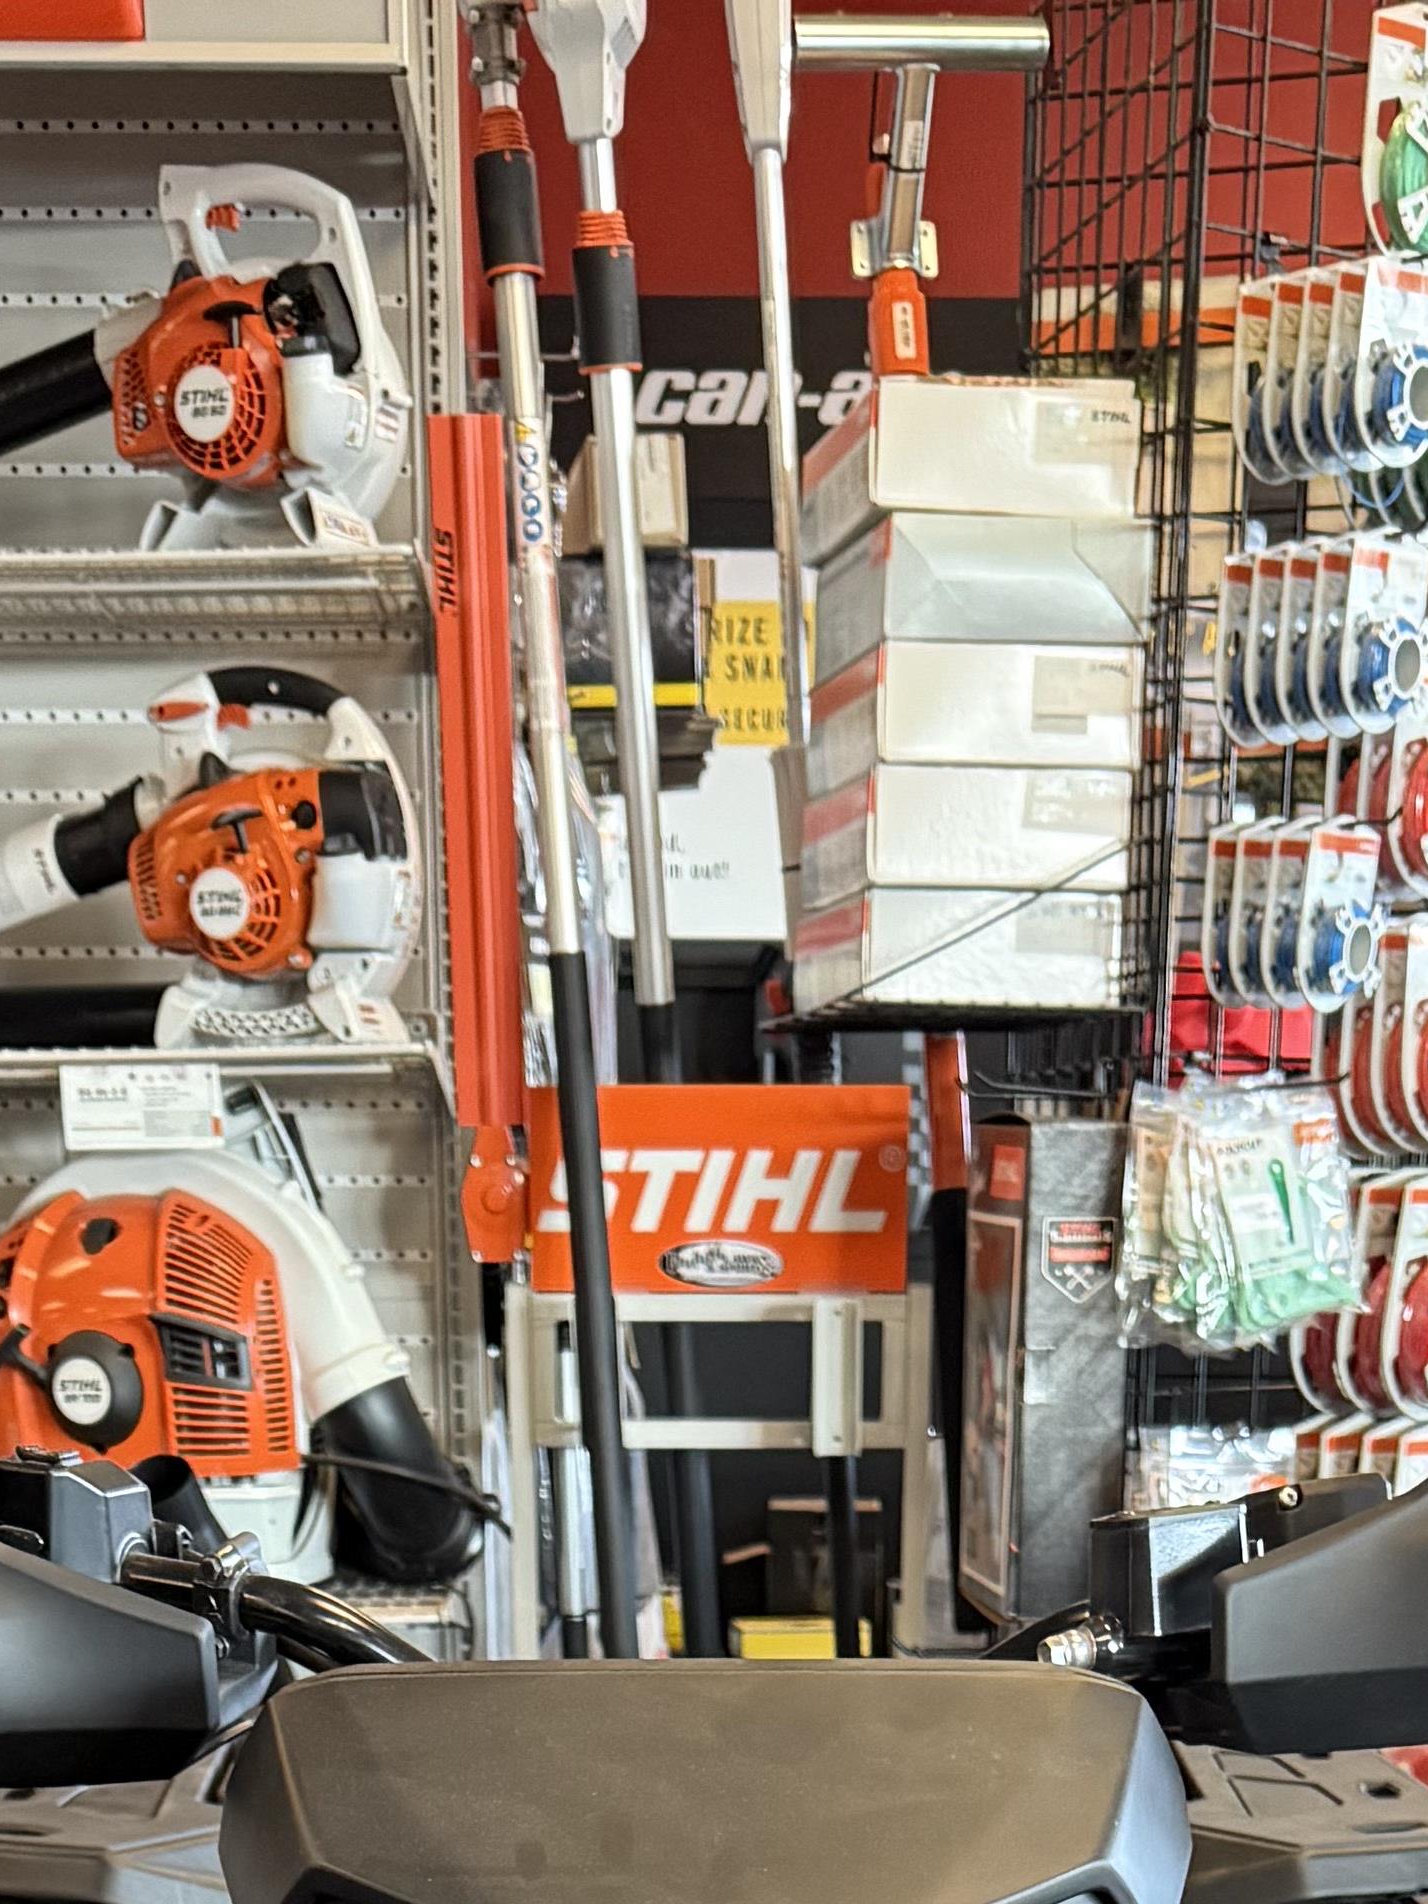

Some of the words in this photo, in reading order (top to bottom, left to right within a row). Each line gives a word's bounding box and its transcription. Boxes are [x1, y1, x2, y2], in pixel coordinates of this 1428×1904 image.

[180, 388, 229, 405] STIHL
[636, 370, 872, 425] can-a
[433, 528, 456, 613] STIHL
[536, 1149, 888, 1233] STIHL
[60, 1379, 102, 1391] STIHL
